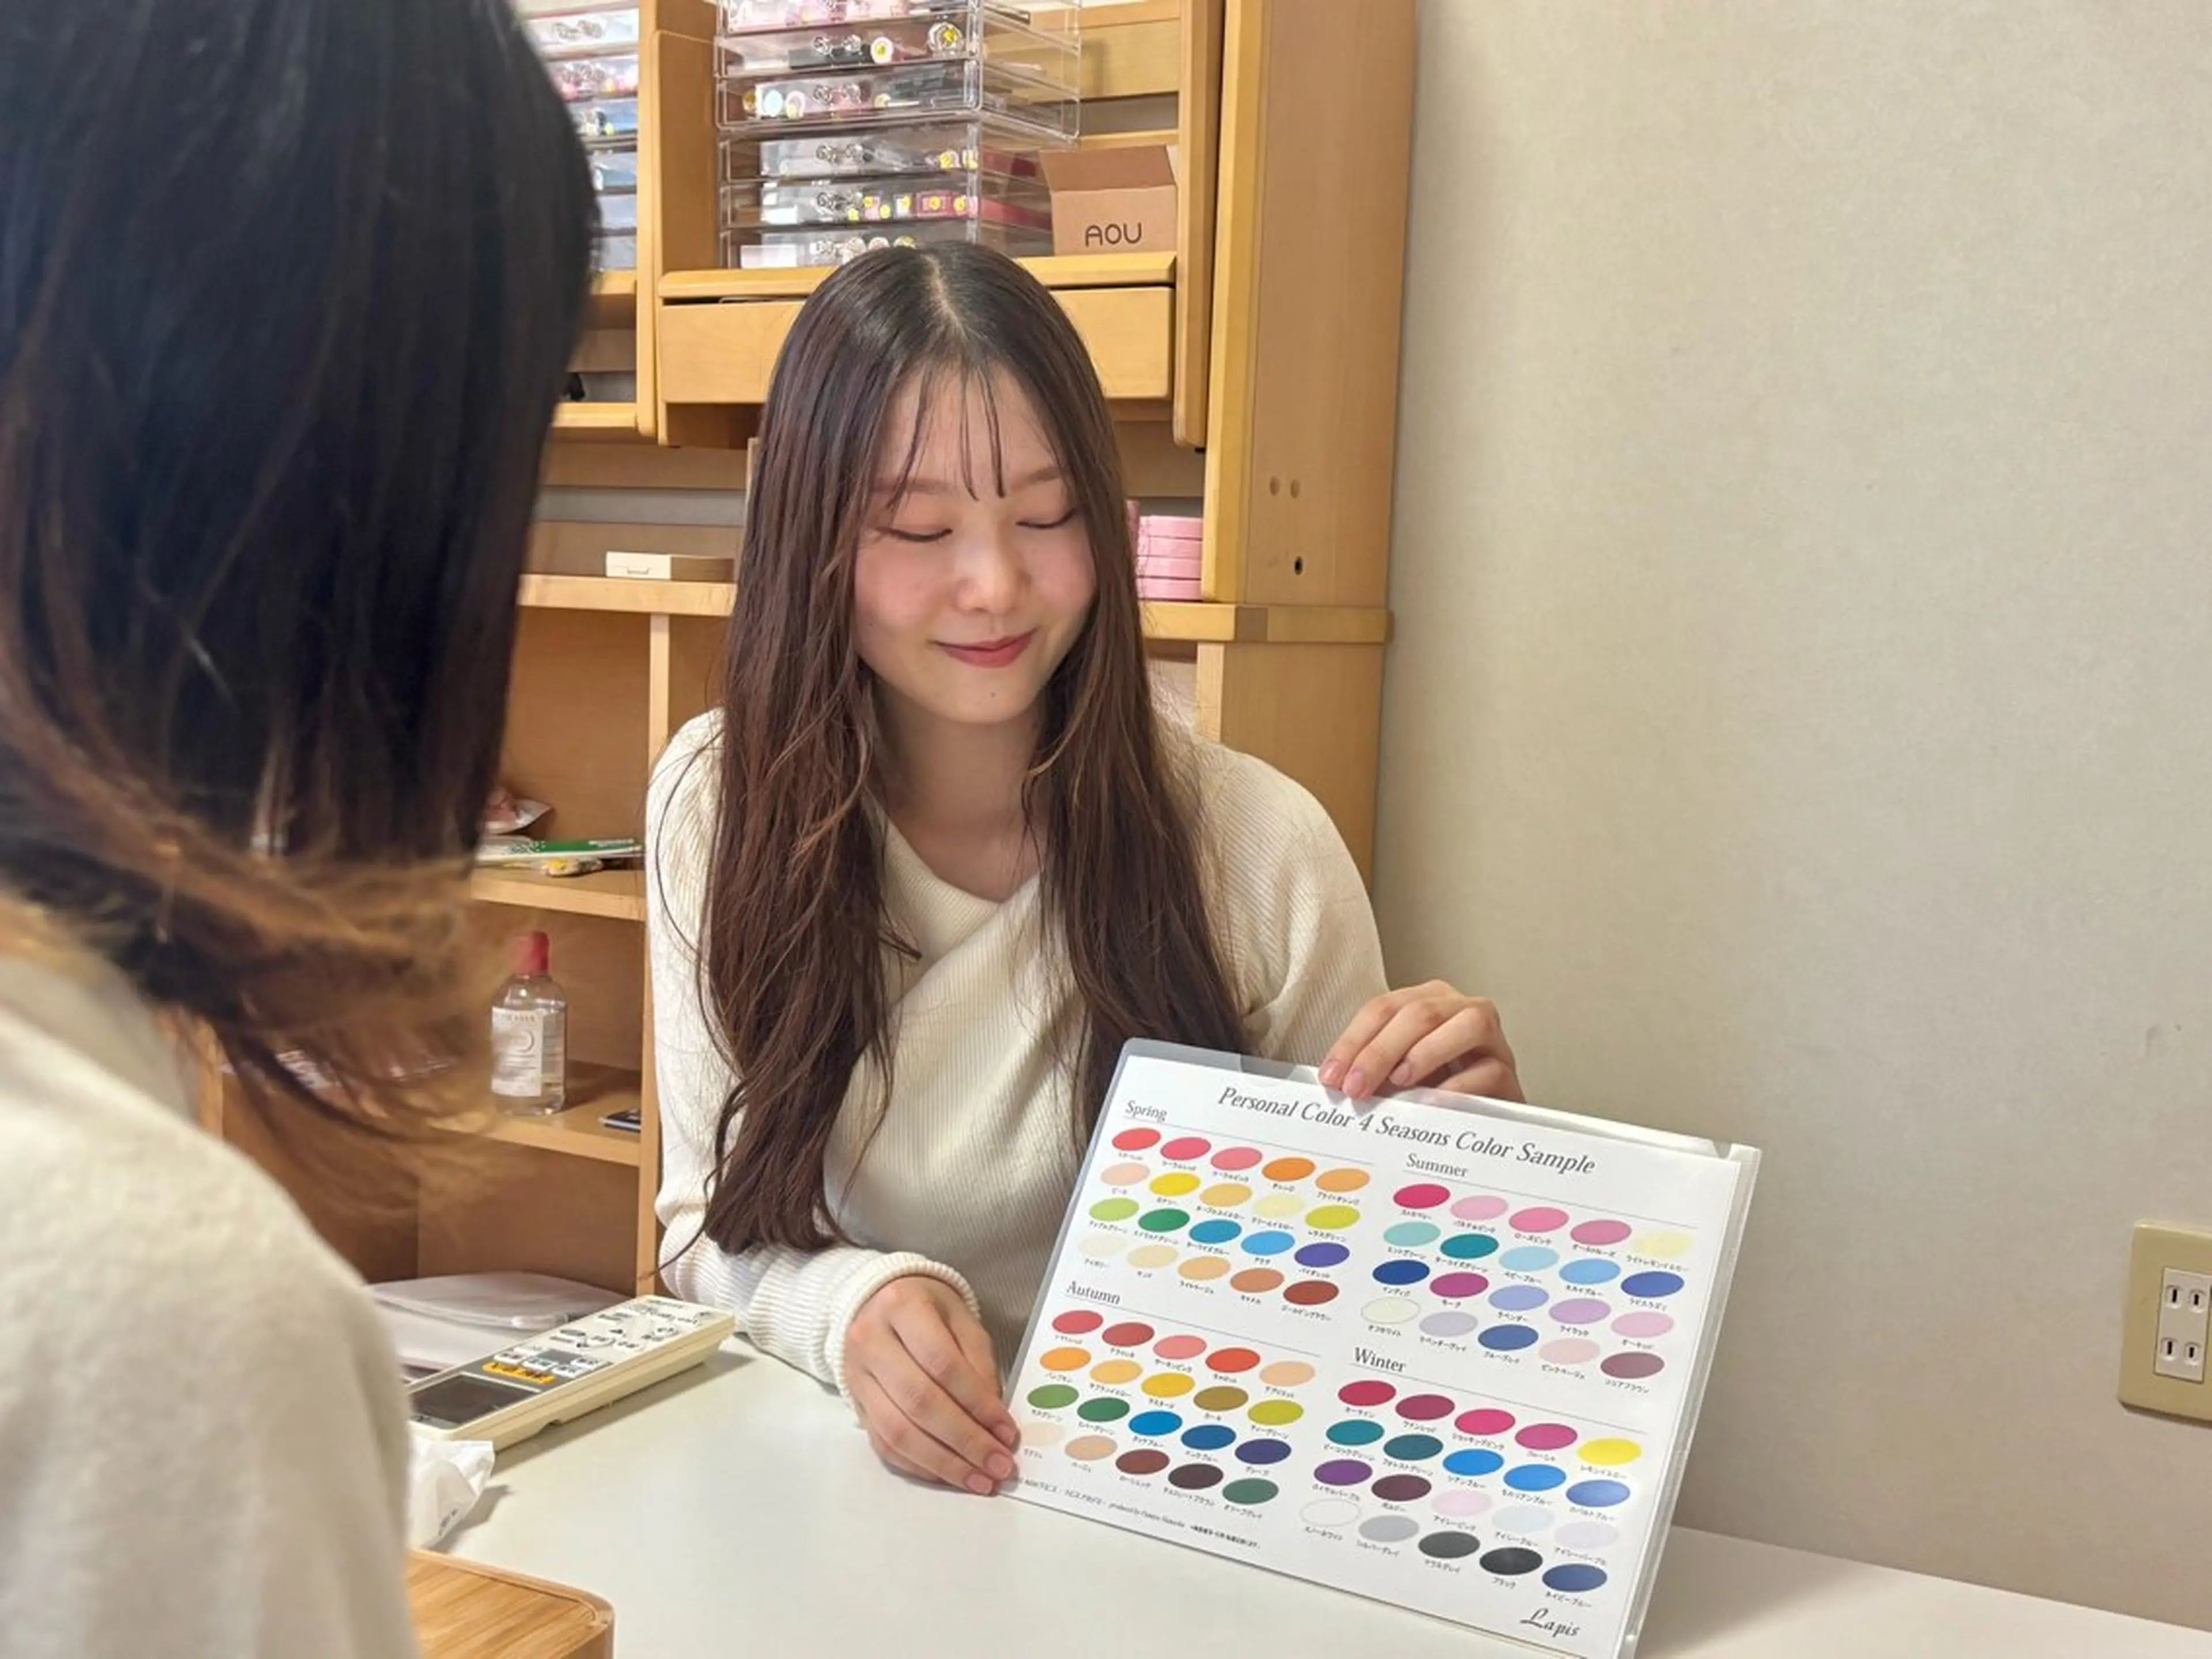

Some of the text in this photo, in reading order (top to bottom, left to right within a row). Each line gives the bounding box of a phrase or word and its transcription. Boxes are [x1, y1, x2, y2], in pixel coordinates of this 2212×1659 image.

[1085, 222, 1142, 247] AOU
[1125, 1100, 1168, 1122] Spring
[1218, 1086, 1597, 1175] Personal Color 4 Seasons Color Sample
[1406, 1153, 1469, 1179] Summer
[1067, 1281, 1120, 1304] Autumn
[1354, 1347, 1406, 1373] Winter
[1520, 1608, 1582, 1638] Lapis
